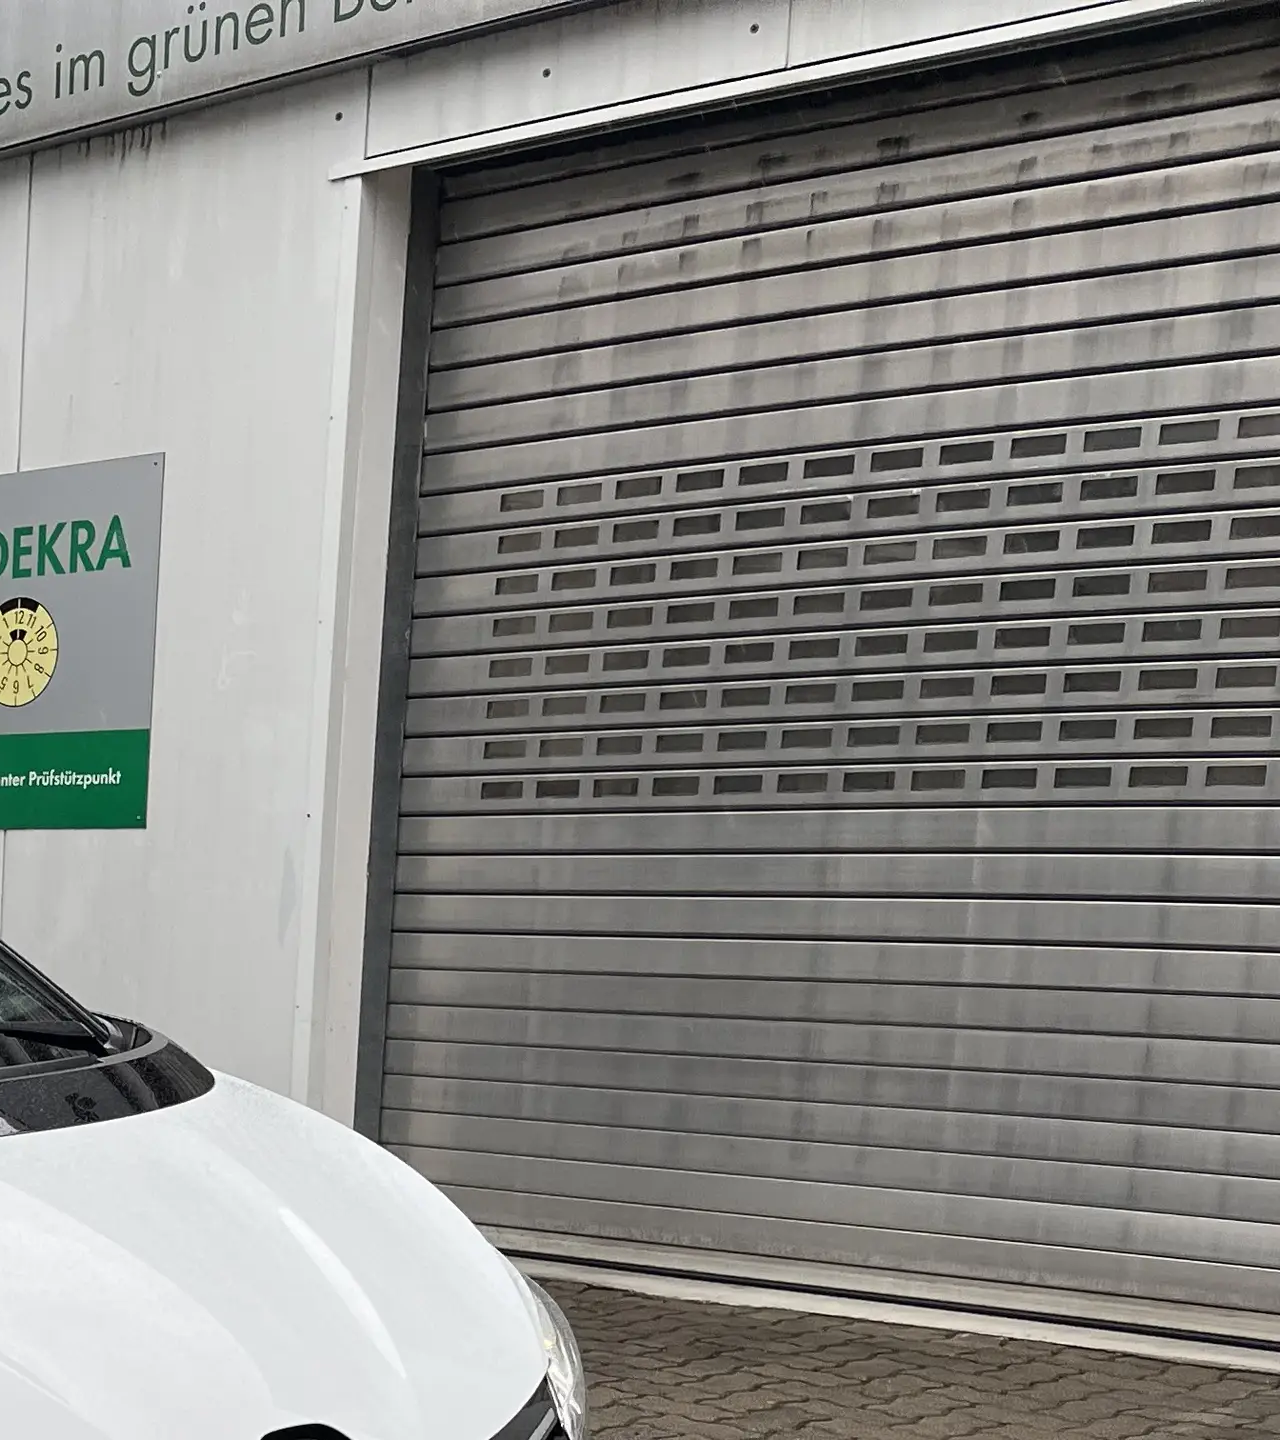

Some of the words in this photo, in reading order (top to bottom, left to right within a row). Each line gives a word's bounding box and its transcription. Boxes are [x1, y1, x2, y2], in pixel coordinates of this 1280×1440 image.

[53, 43, 106, 99] im
[127, 0, 305, 97] grünen
[3, 617, 9, 629] 1
[14, 610, 25, 625] 12
[27, 613, 37, 629] 11
[35, 625, 47, 642] 10
[34, 663, 45, 674] 8
[28, 765, 122, 790] Prüfstützpunkt
